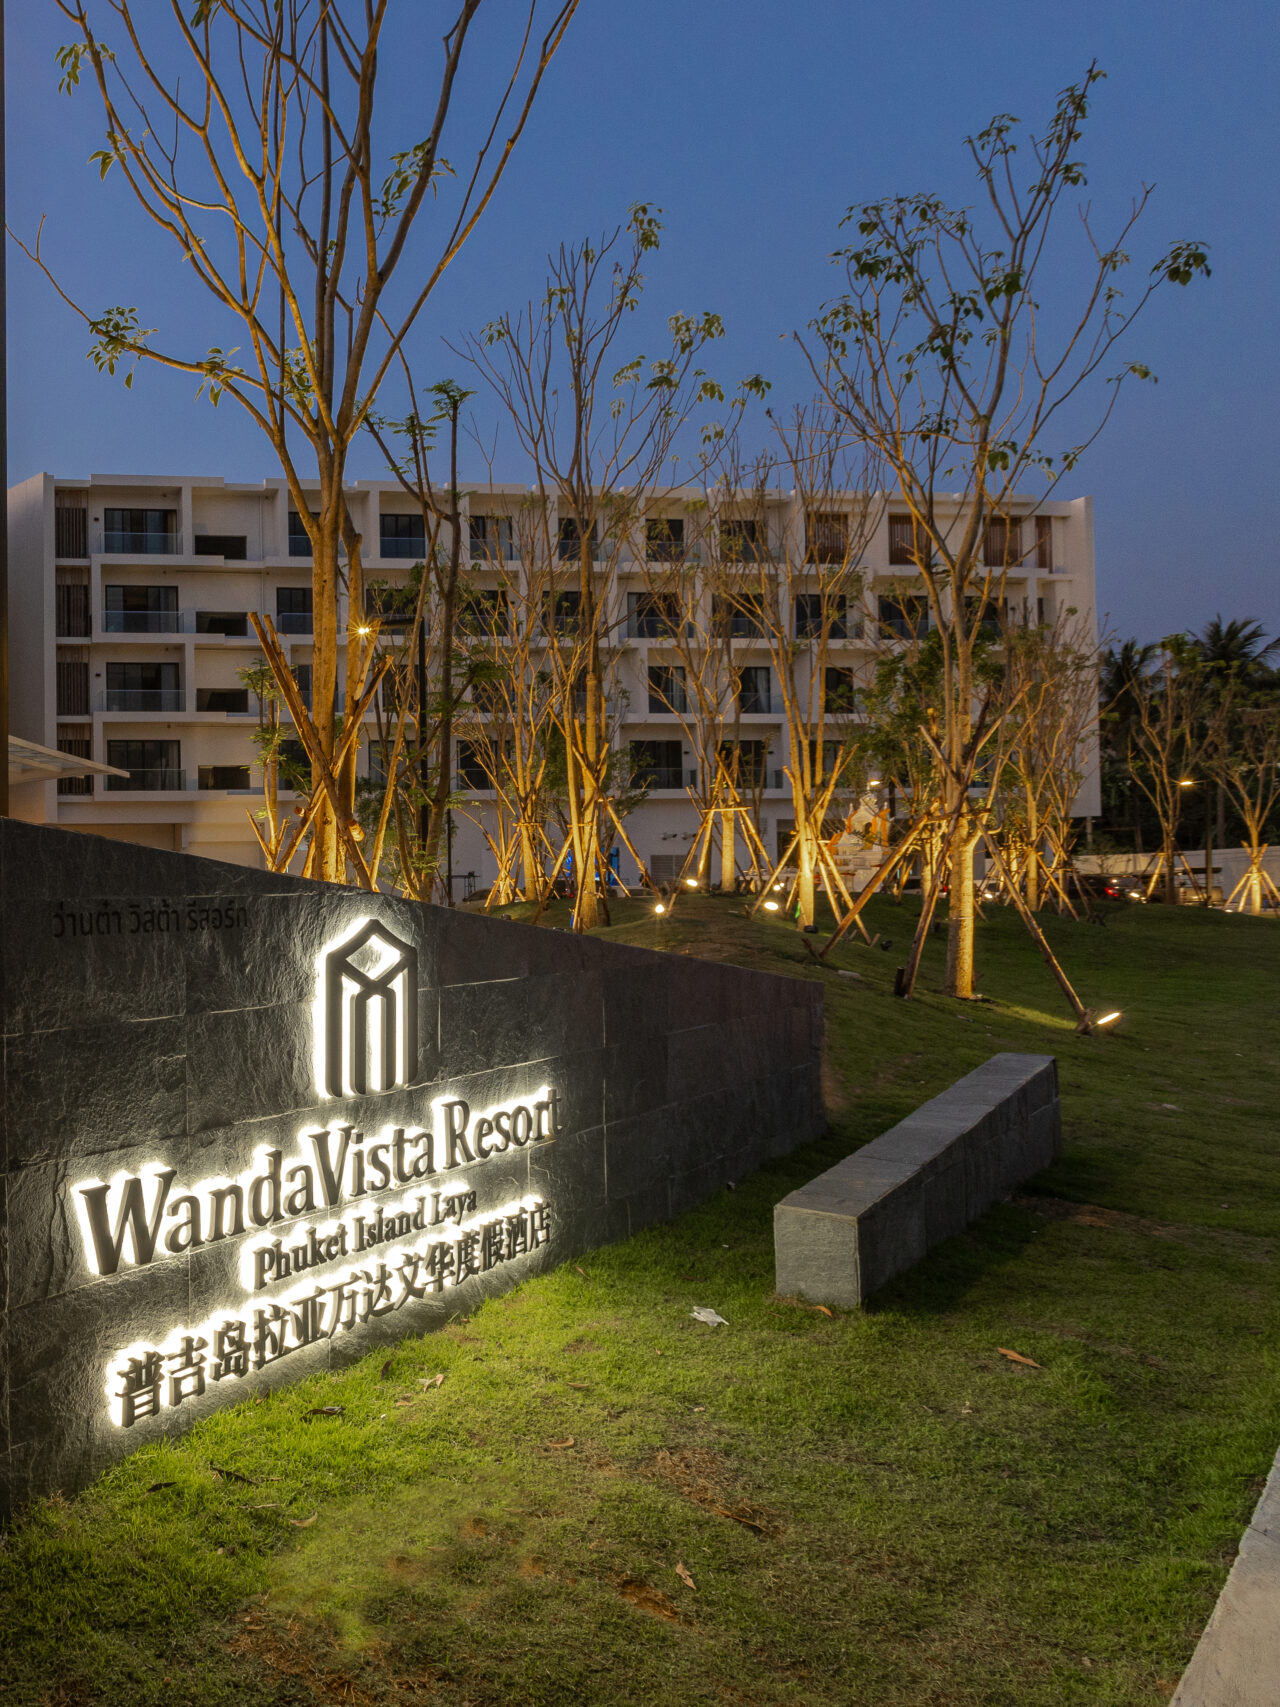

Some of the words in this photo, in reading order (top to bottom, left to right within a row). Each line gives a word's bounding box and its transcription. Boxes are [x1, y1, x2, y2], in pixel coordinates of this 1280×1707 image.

[79, 1125, 437, 1277] WandaVista
[440, 1088, 562, 1170] Resort
[253, 1222, 349, 1290] Phuket
[351, 1195, 427, 1253] Island
[428, 1190, 478, 1226] Laya
[114, 1200, 552, 1429] 普吉岛拉亚万达文华度假酒店
